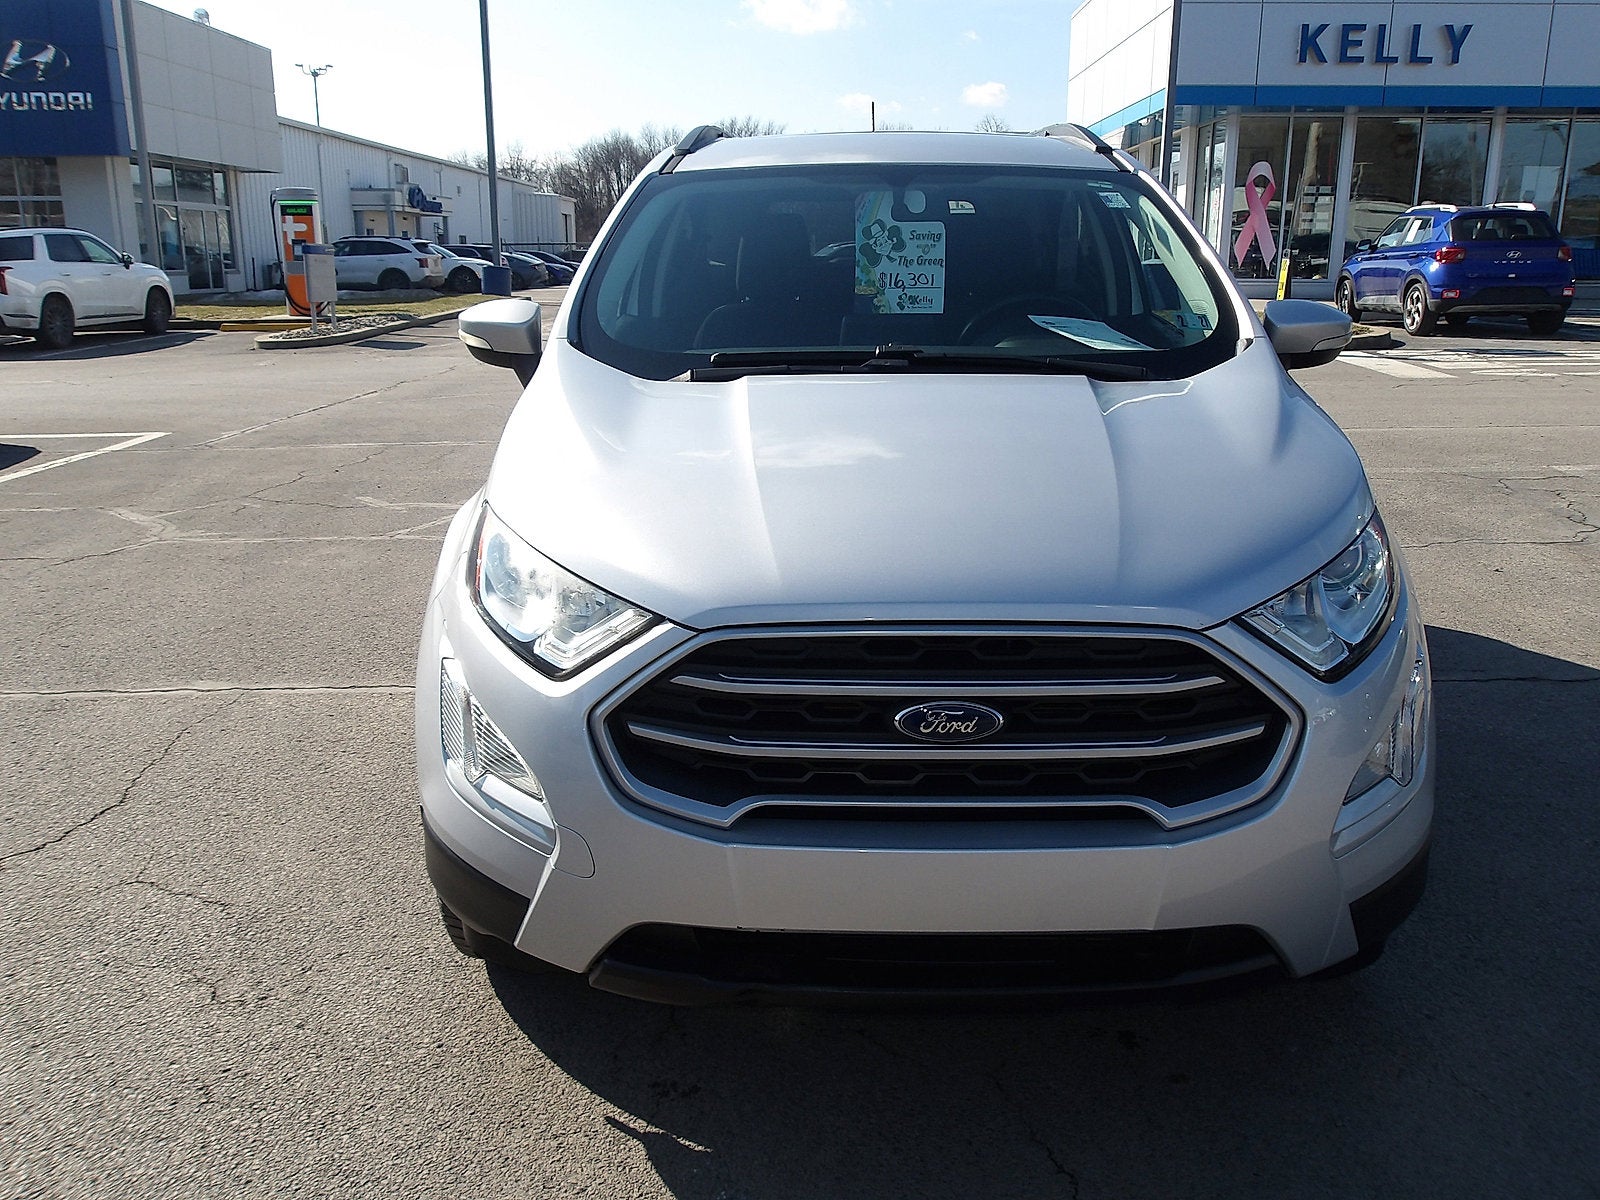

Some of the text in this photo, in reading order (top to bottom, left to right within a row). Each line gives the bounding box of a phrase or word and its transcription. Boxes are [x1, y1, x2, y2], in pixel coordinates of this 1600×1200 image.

[1298, 24, 1474, 64] KELLY
[909, 230, 942, 242] Saving
[897, 255, 944, 268] The Green
[878, 272, 935, 292] $16,301
[920, 710, 979, 733] Ford
